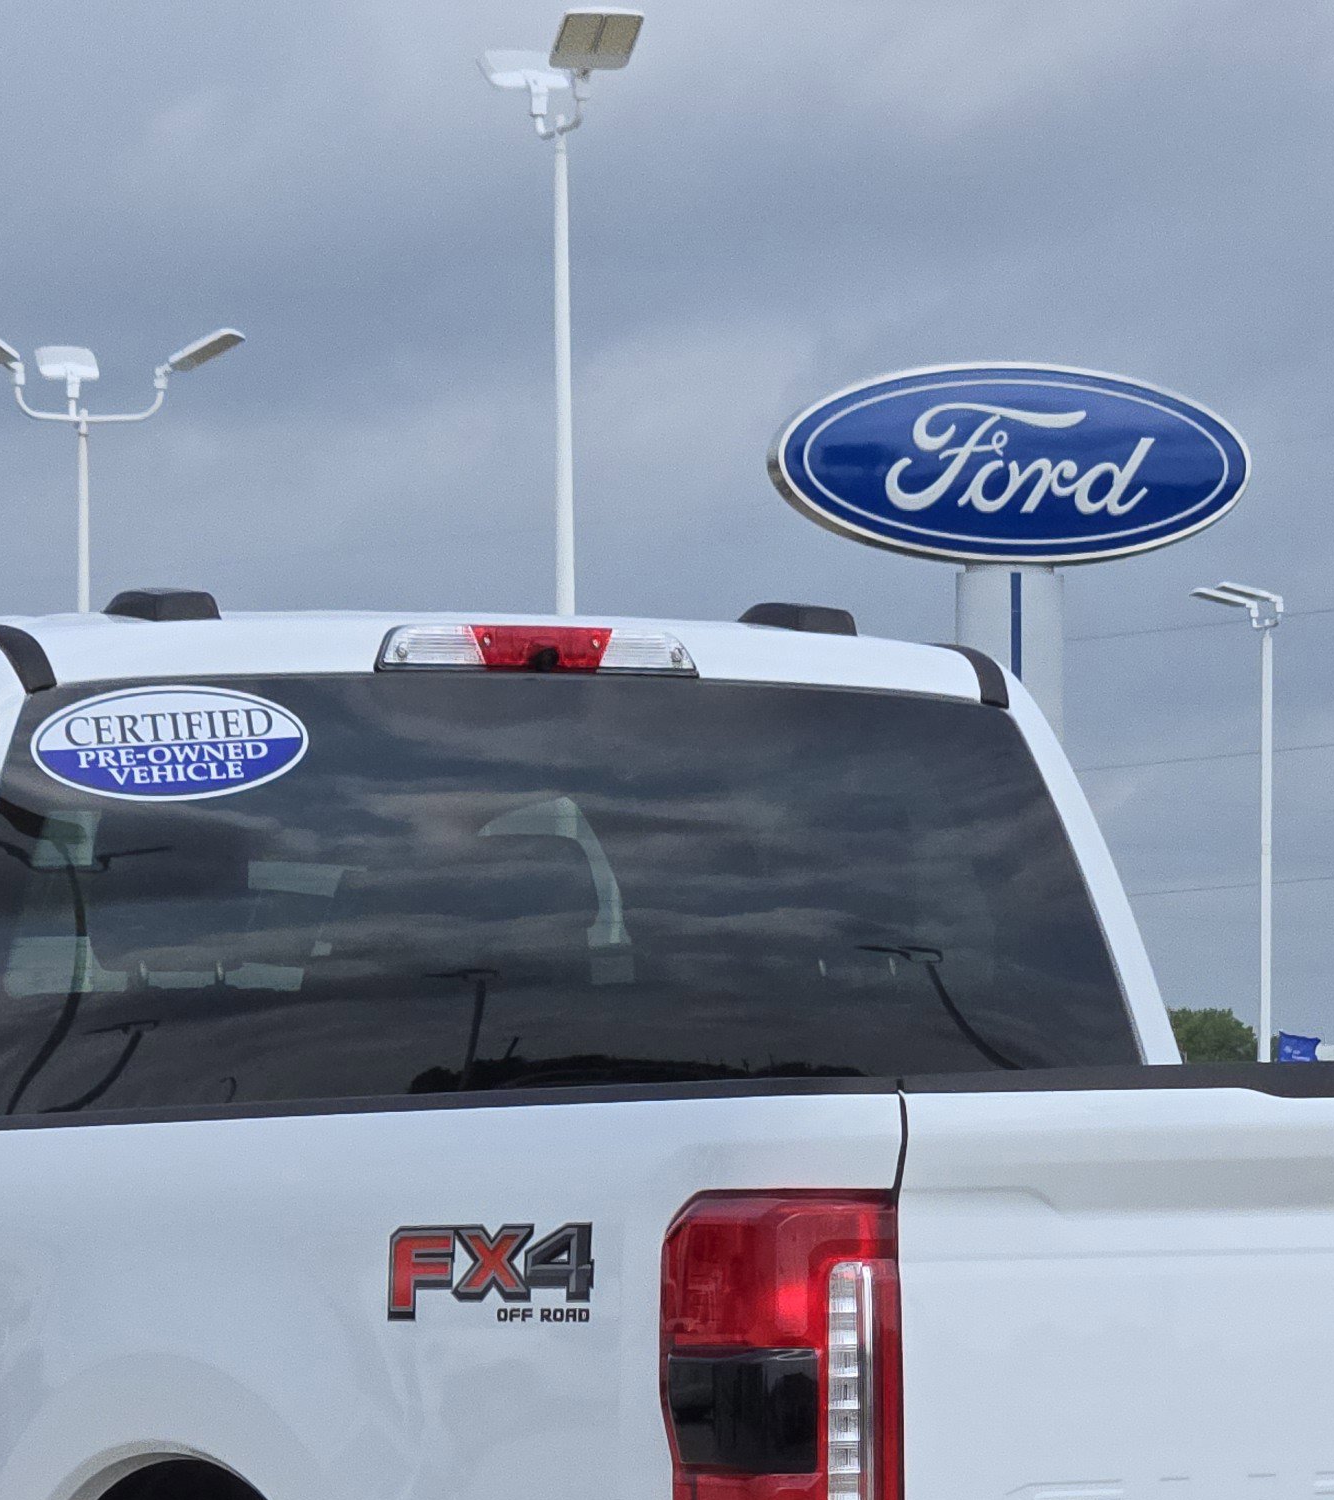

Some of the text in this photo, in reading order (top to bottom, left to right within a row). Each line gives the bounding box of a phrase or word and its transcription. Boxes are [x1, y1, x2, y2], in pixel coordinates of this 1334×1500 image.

[884, 402, 1156, 517] Ford
[64, 707, 273, 747] CERTIFIED
[76, 741, 269, 769] PRE-OWNED
[108, 761, 246, 786] VEHICLE
[387, 1221, 595, 1322] FX4
[496, 1307, 591, 1323] OFF ROAD
